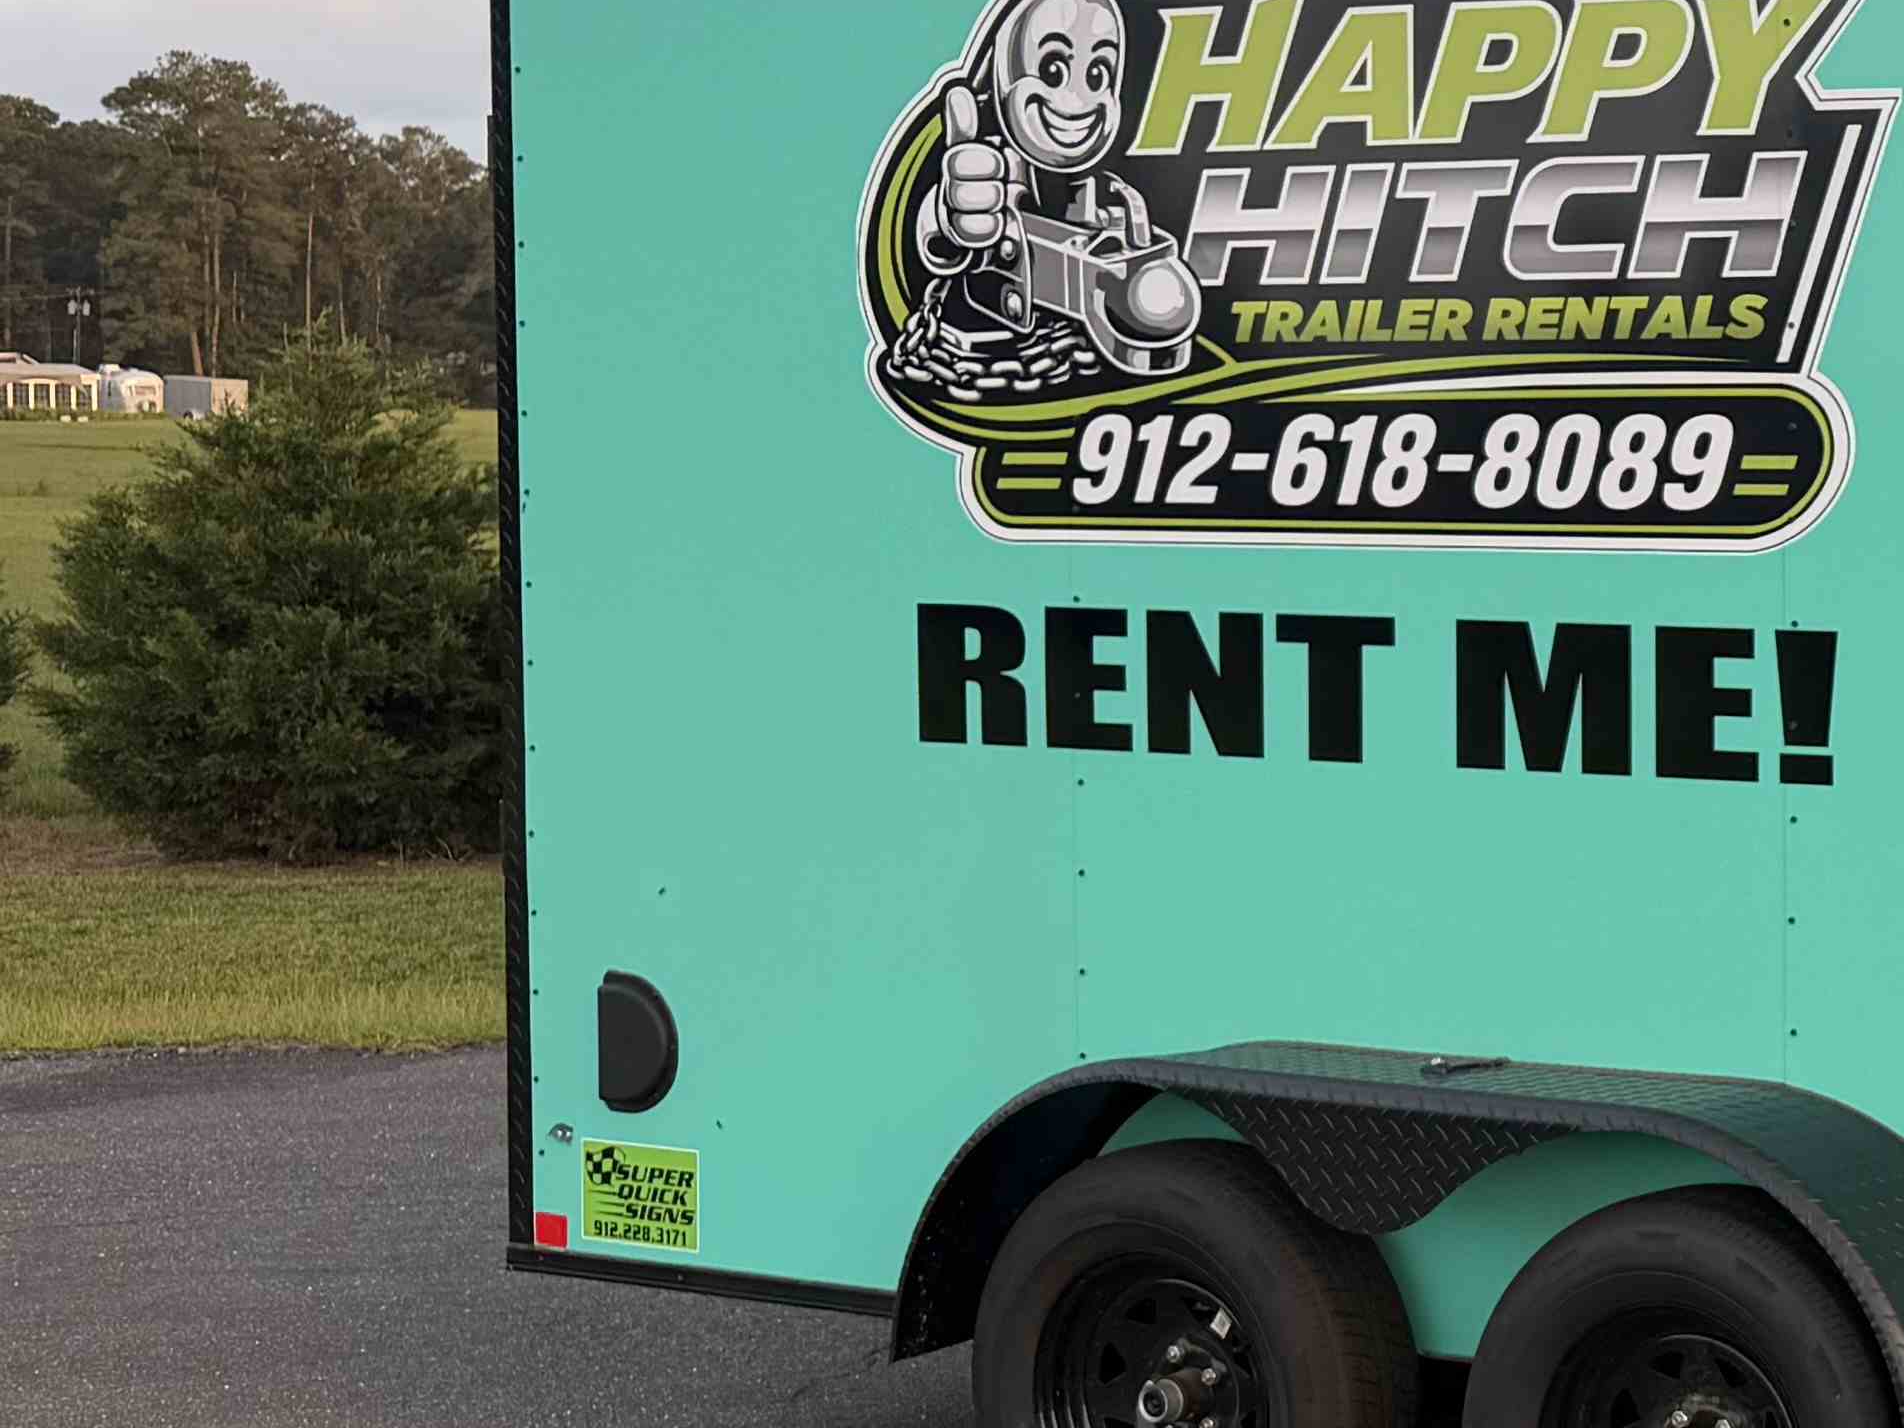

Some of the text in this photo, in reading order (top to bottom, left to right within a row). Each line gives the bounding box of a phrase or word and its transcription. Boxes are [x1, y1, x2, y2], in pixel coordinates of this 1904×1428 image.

[1184, 149, 1808, 287] HITCH
[1230, 293, 1767, 344] TRAILER RENTALS
[1071, 412, 1735, 512] 912-618-8089
[917, 603, 1839, 786] RENT ME!
[615, 1163, 695, 1189] SUPER
[616, 1183, 688, 1207] QUICK
[624, 1203, 695, 1226] SIGNS
